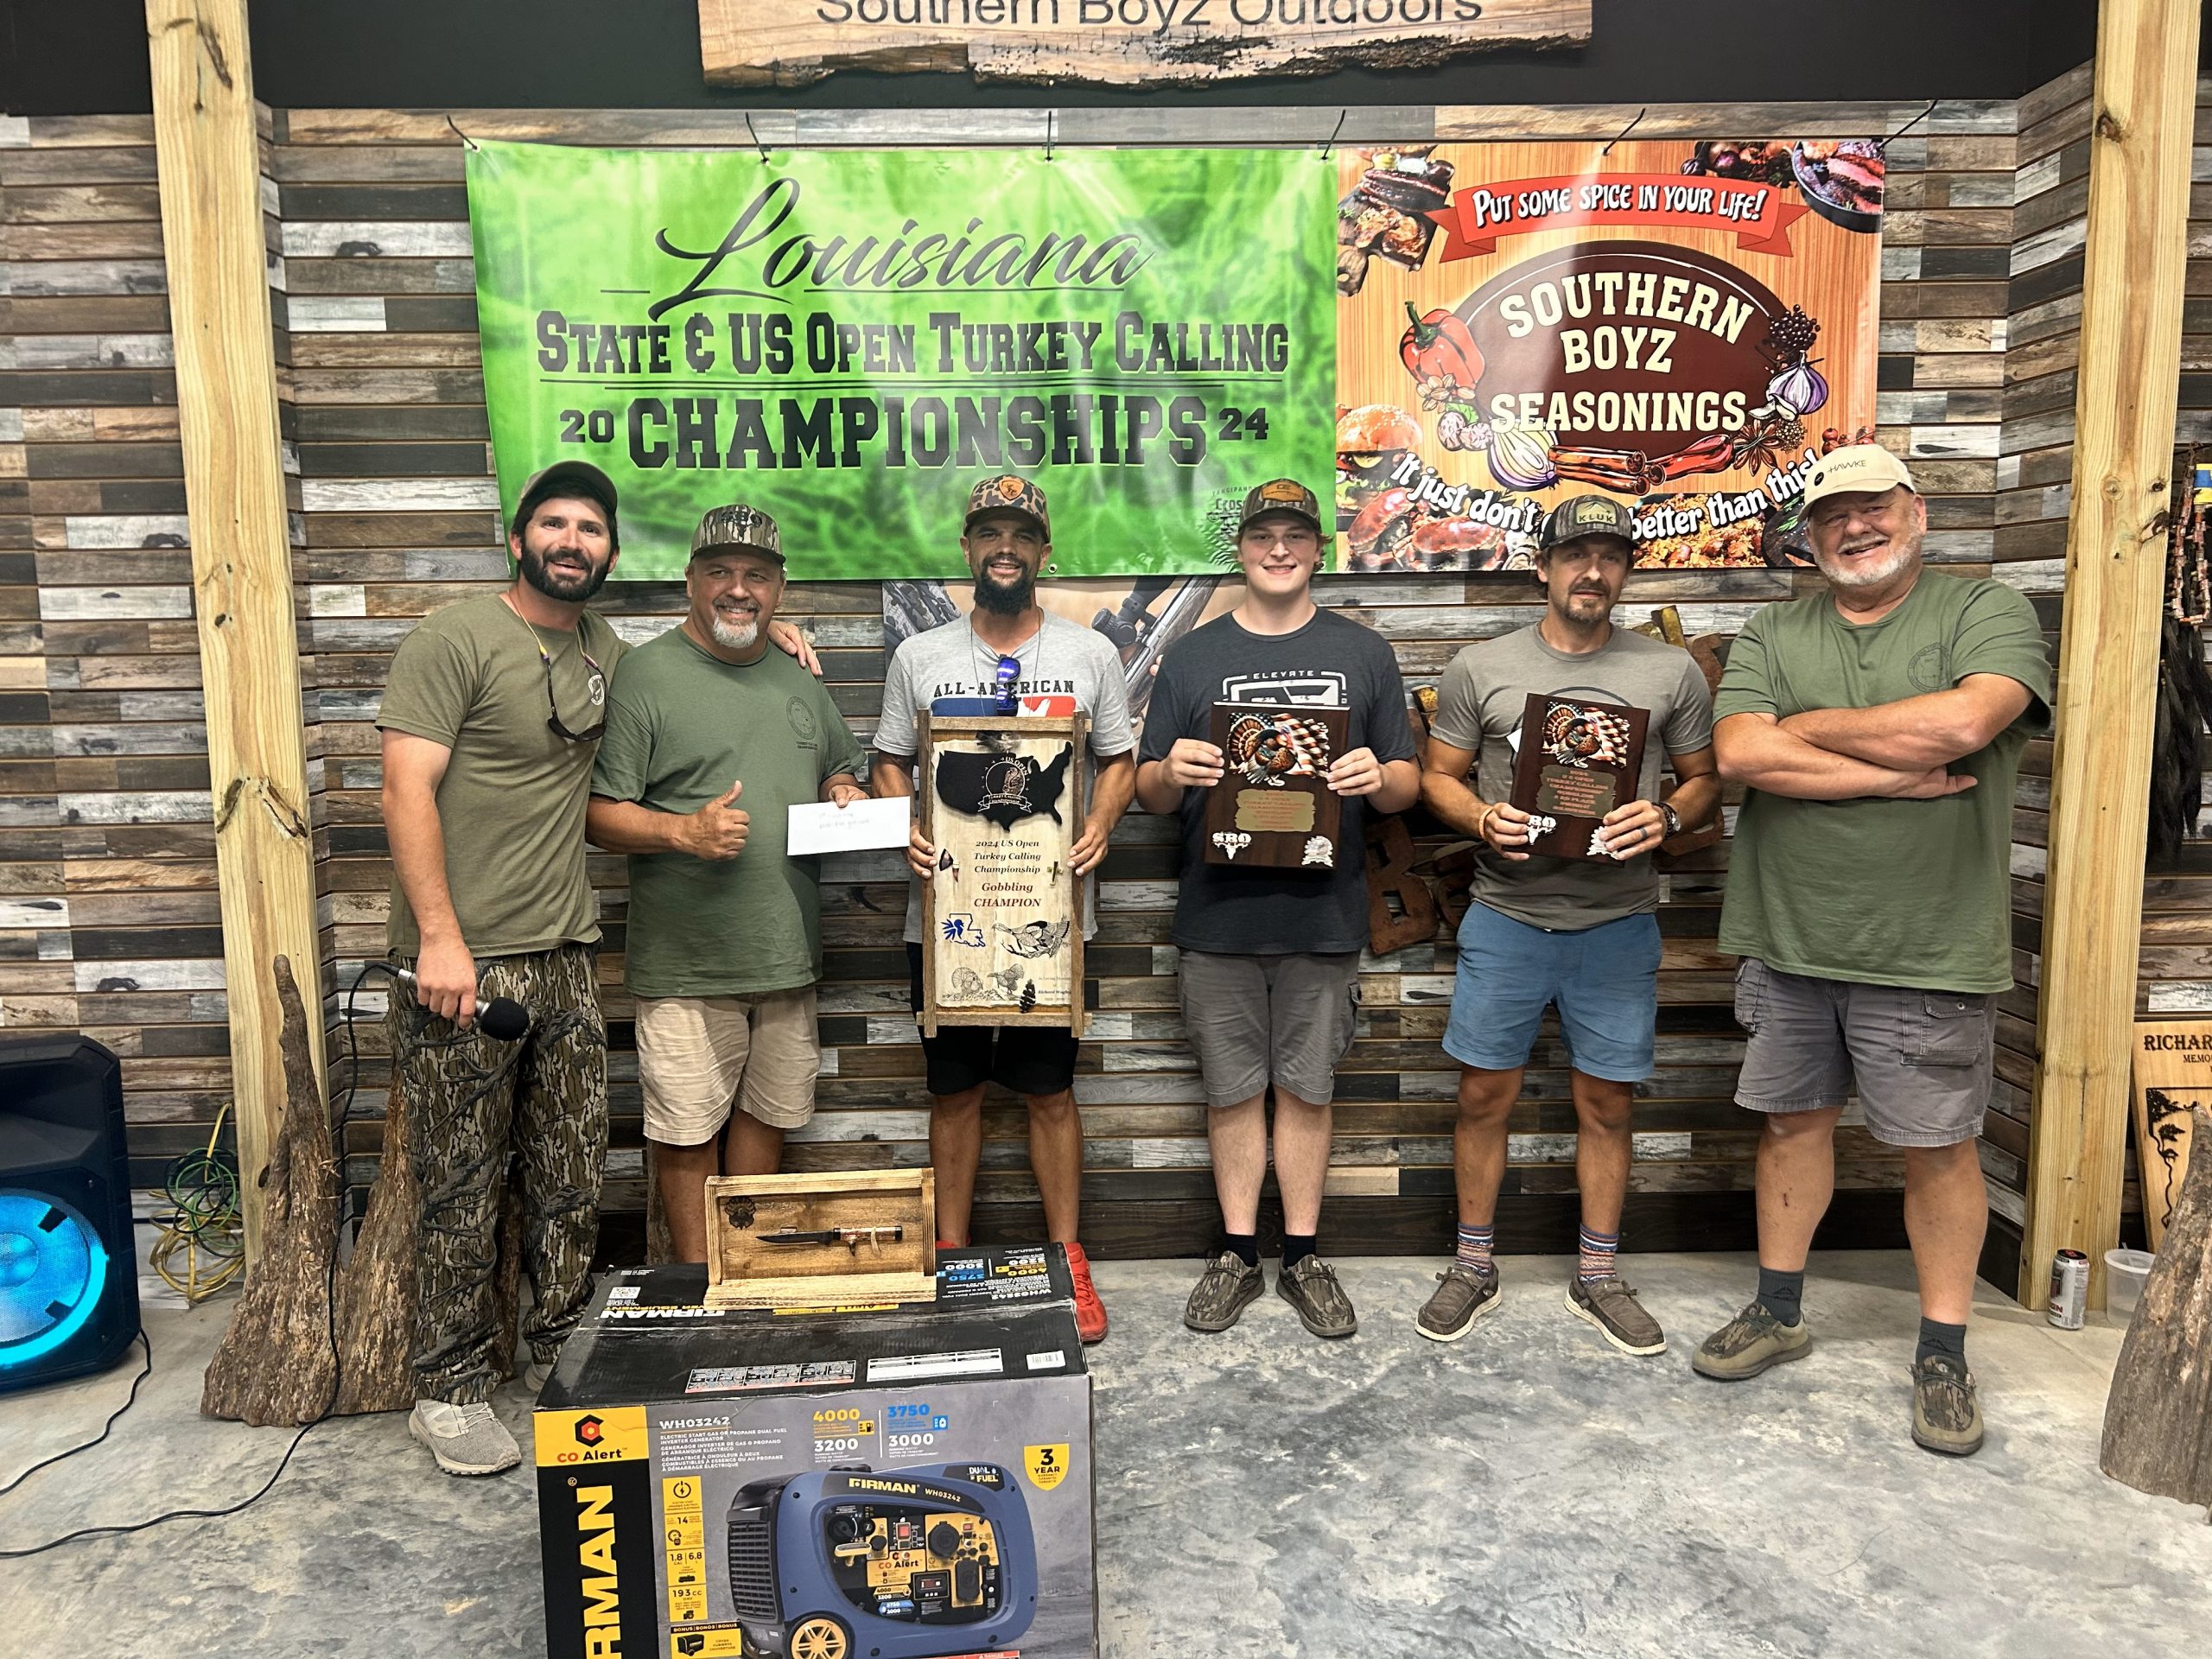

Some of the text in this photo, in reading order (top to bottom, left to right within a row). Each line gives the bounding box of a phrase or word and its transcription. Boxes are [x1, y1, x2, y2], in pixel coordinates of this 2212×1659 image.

[817, 0, 1482, 36] Southern Boyz Outdoors
[1472, 184, 1767, 227] PUT SOME SPICE IN YOUR LIFE!
[648, 177, 1155, 323] Louisiana
[1500, 272, 1754, 345] SOUTHERN
[685, 313, 715, 373] &
[728, 313, 794, 374] US
[1560, 327, 1677, 374] BOYZ
[1491, 391, 1746, 433] SEASONINGS
[560, 394, 1268, 470] 20 CHAMPIONSHIPS 24
[1391, 452, 1419, 482] It
[1408, 463, 1468, 512] just
[1471, 497, 1535, 534] don't
[1216, 498, 1245, 512] Cros
[1580, 513, 1613, 523] KLUK
[1630, 503, 1700, 542] better
[1708, 489, 1767, 525] than
[1253, 671, 1314, 679] ELEVATE
[1015, 840, 1039, 849] Open
[975, 853, 1041, 861] Turkey Calling
[975, 865, 1040, 874] Championship
[982, 882, 1033, 893] Gobbling
[974, 899, 1042, 907] CHAMPION
[2183, 1054, 2212, 1064] MEMO
[813, 1408, 861, 1422] 4000
[887, 1403, 930, 1418] 3750
[814, 1438, 859, 1452] 3200
[888, 1433, 934, 1447] 3000
[557, 1448, 622, 1463] CO Alert
[1040, 1448, 1054, 1466] 3
[976, 1474, 998, 1483] FUEL
[849, 1478, 916, 1494] FIRMAN
[671, 1553, 683, 1561] 1.8
[689, 1552, 702, 1560] 6.8
[894, 1560, 918, 1568] Alert
